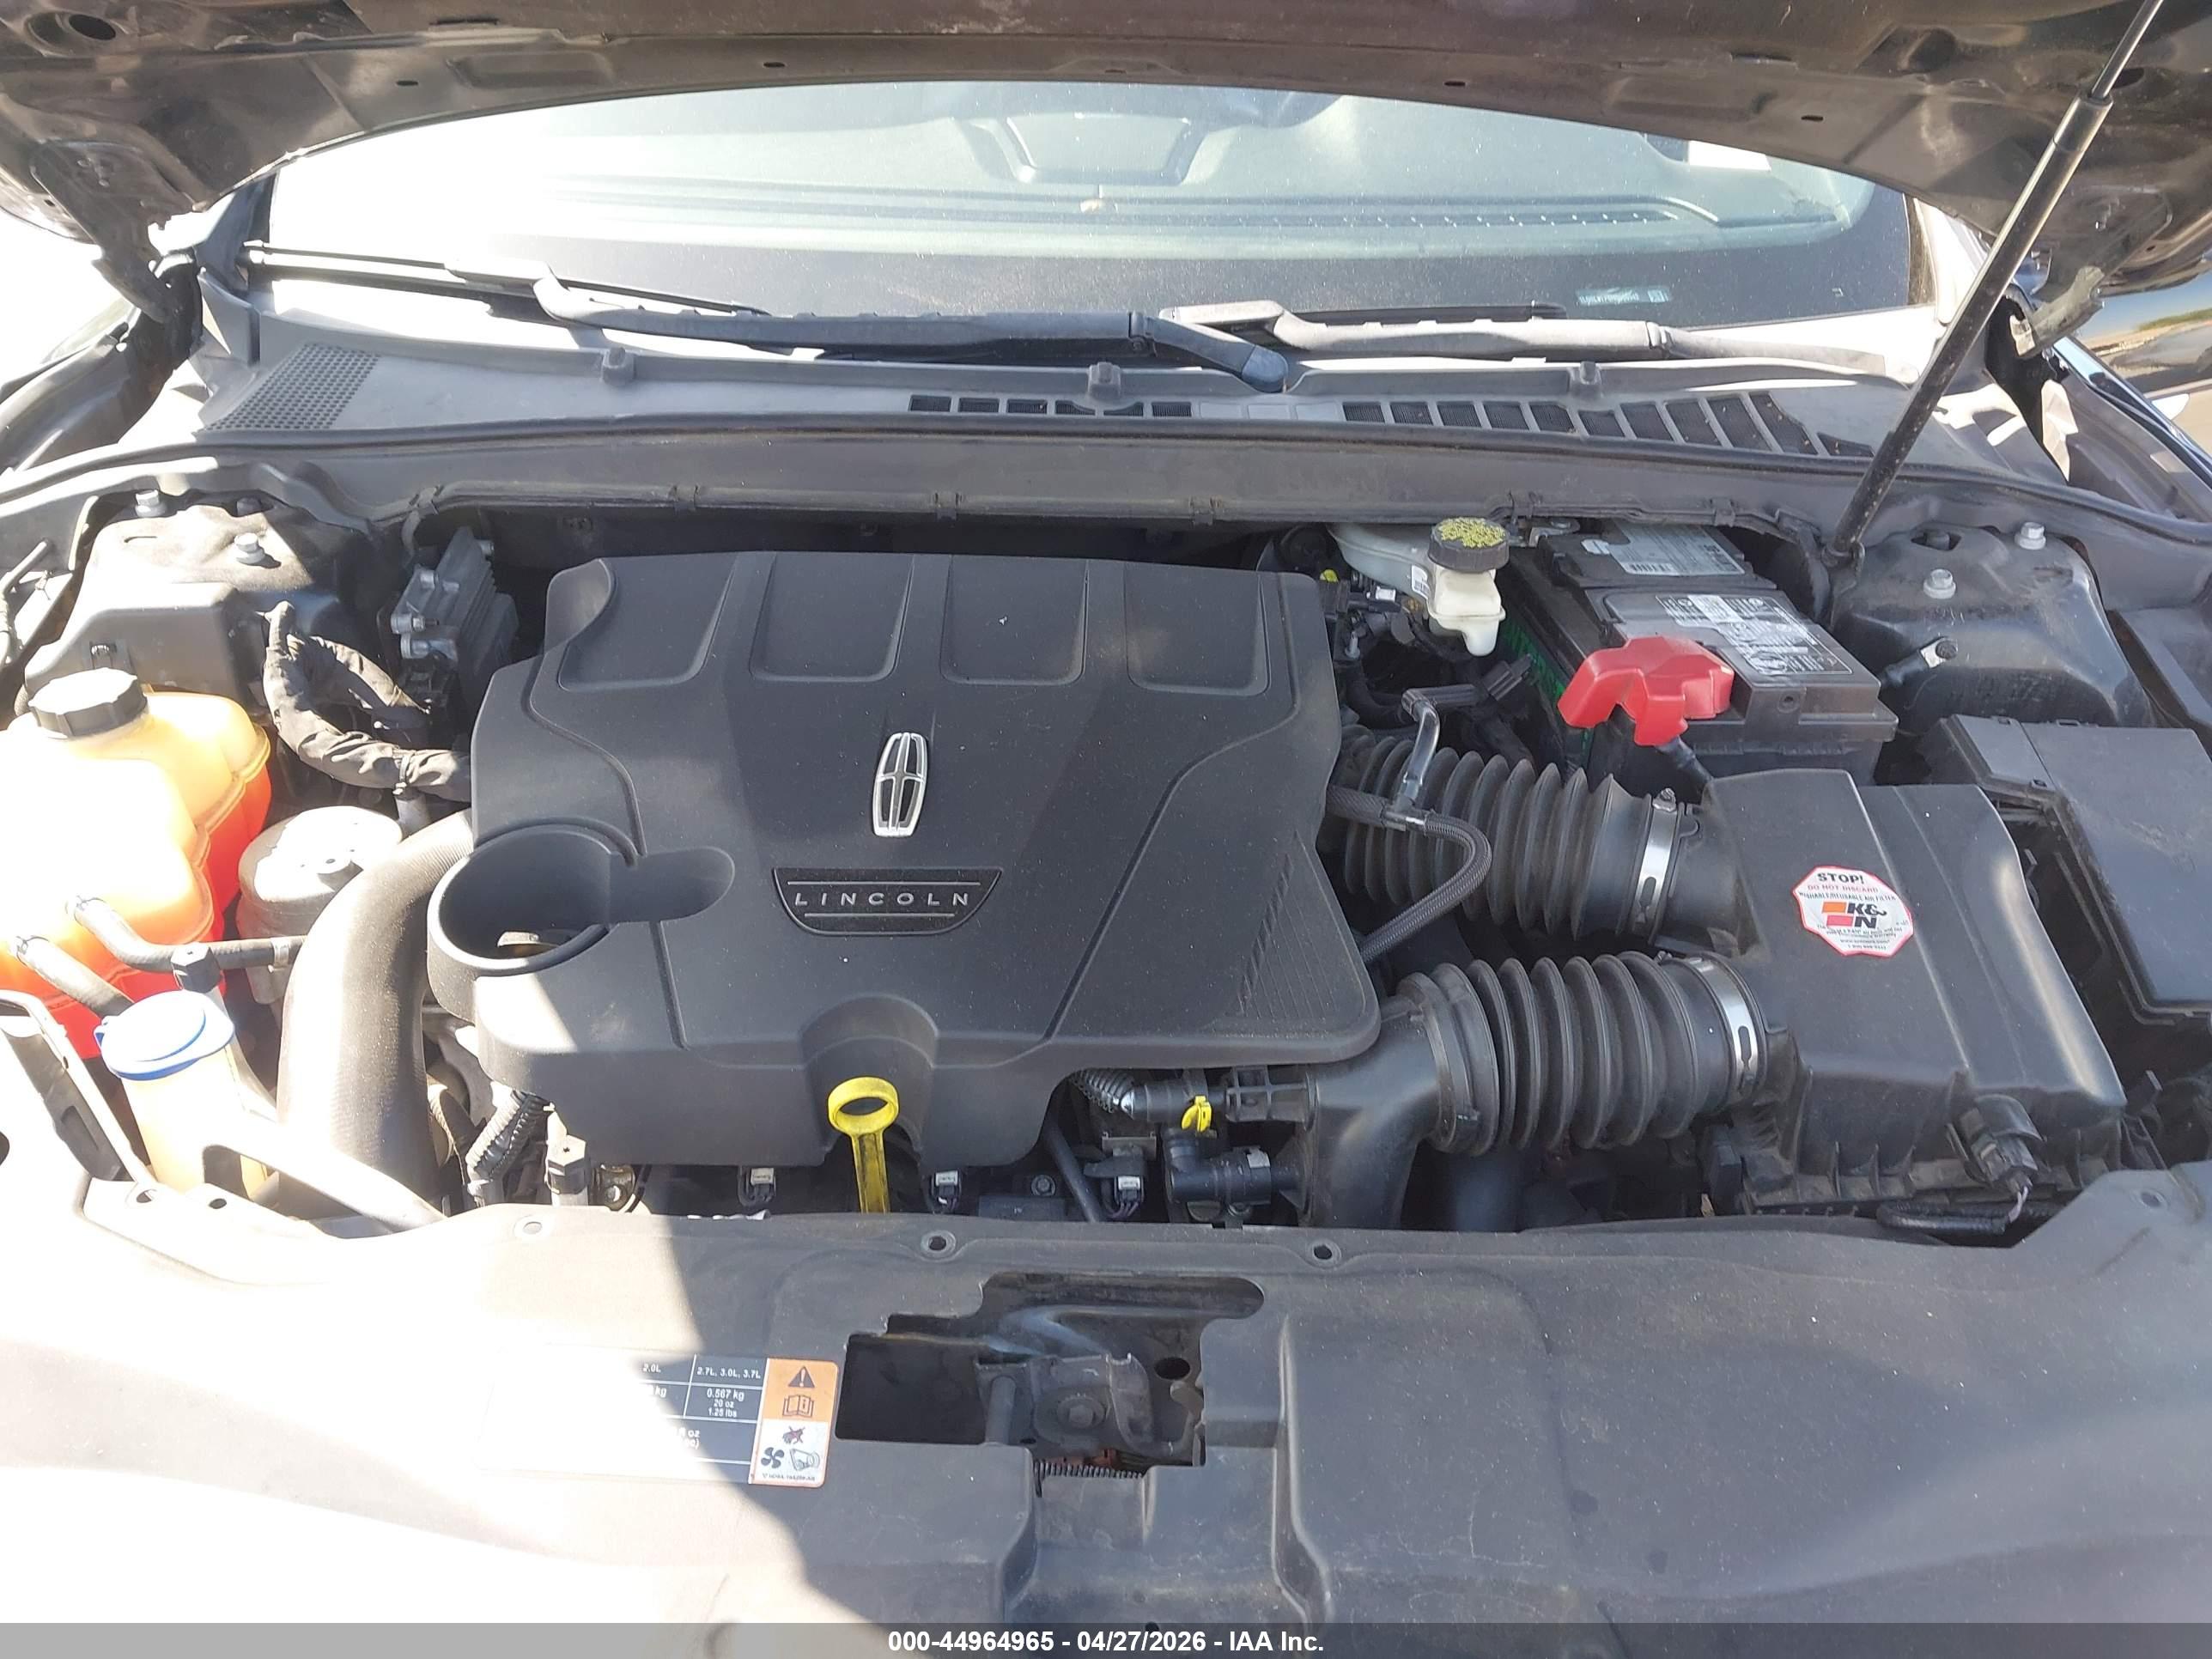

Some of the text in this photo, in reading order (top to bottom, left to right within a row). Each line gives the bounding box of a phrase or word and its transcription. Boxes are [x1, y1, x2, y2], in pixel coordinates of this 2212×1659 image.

[1817, 872, 1864, 884] STOP!
[1843, 885, 1879, 894] DISCARD
[795, 892, 969, 906] LINCOLN
[696, 1366, 762, 1379] 2.7L, 3.0L, 3.7L
[654, 1385, 667, 1399] kg
[707, 1388, 745, 1402] 0.567 kg
[714, 1399, 723, 1408] 20
[725, 1408, 738, 1418] lbs
[688, 1430, 700, 1438] oz
